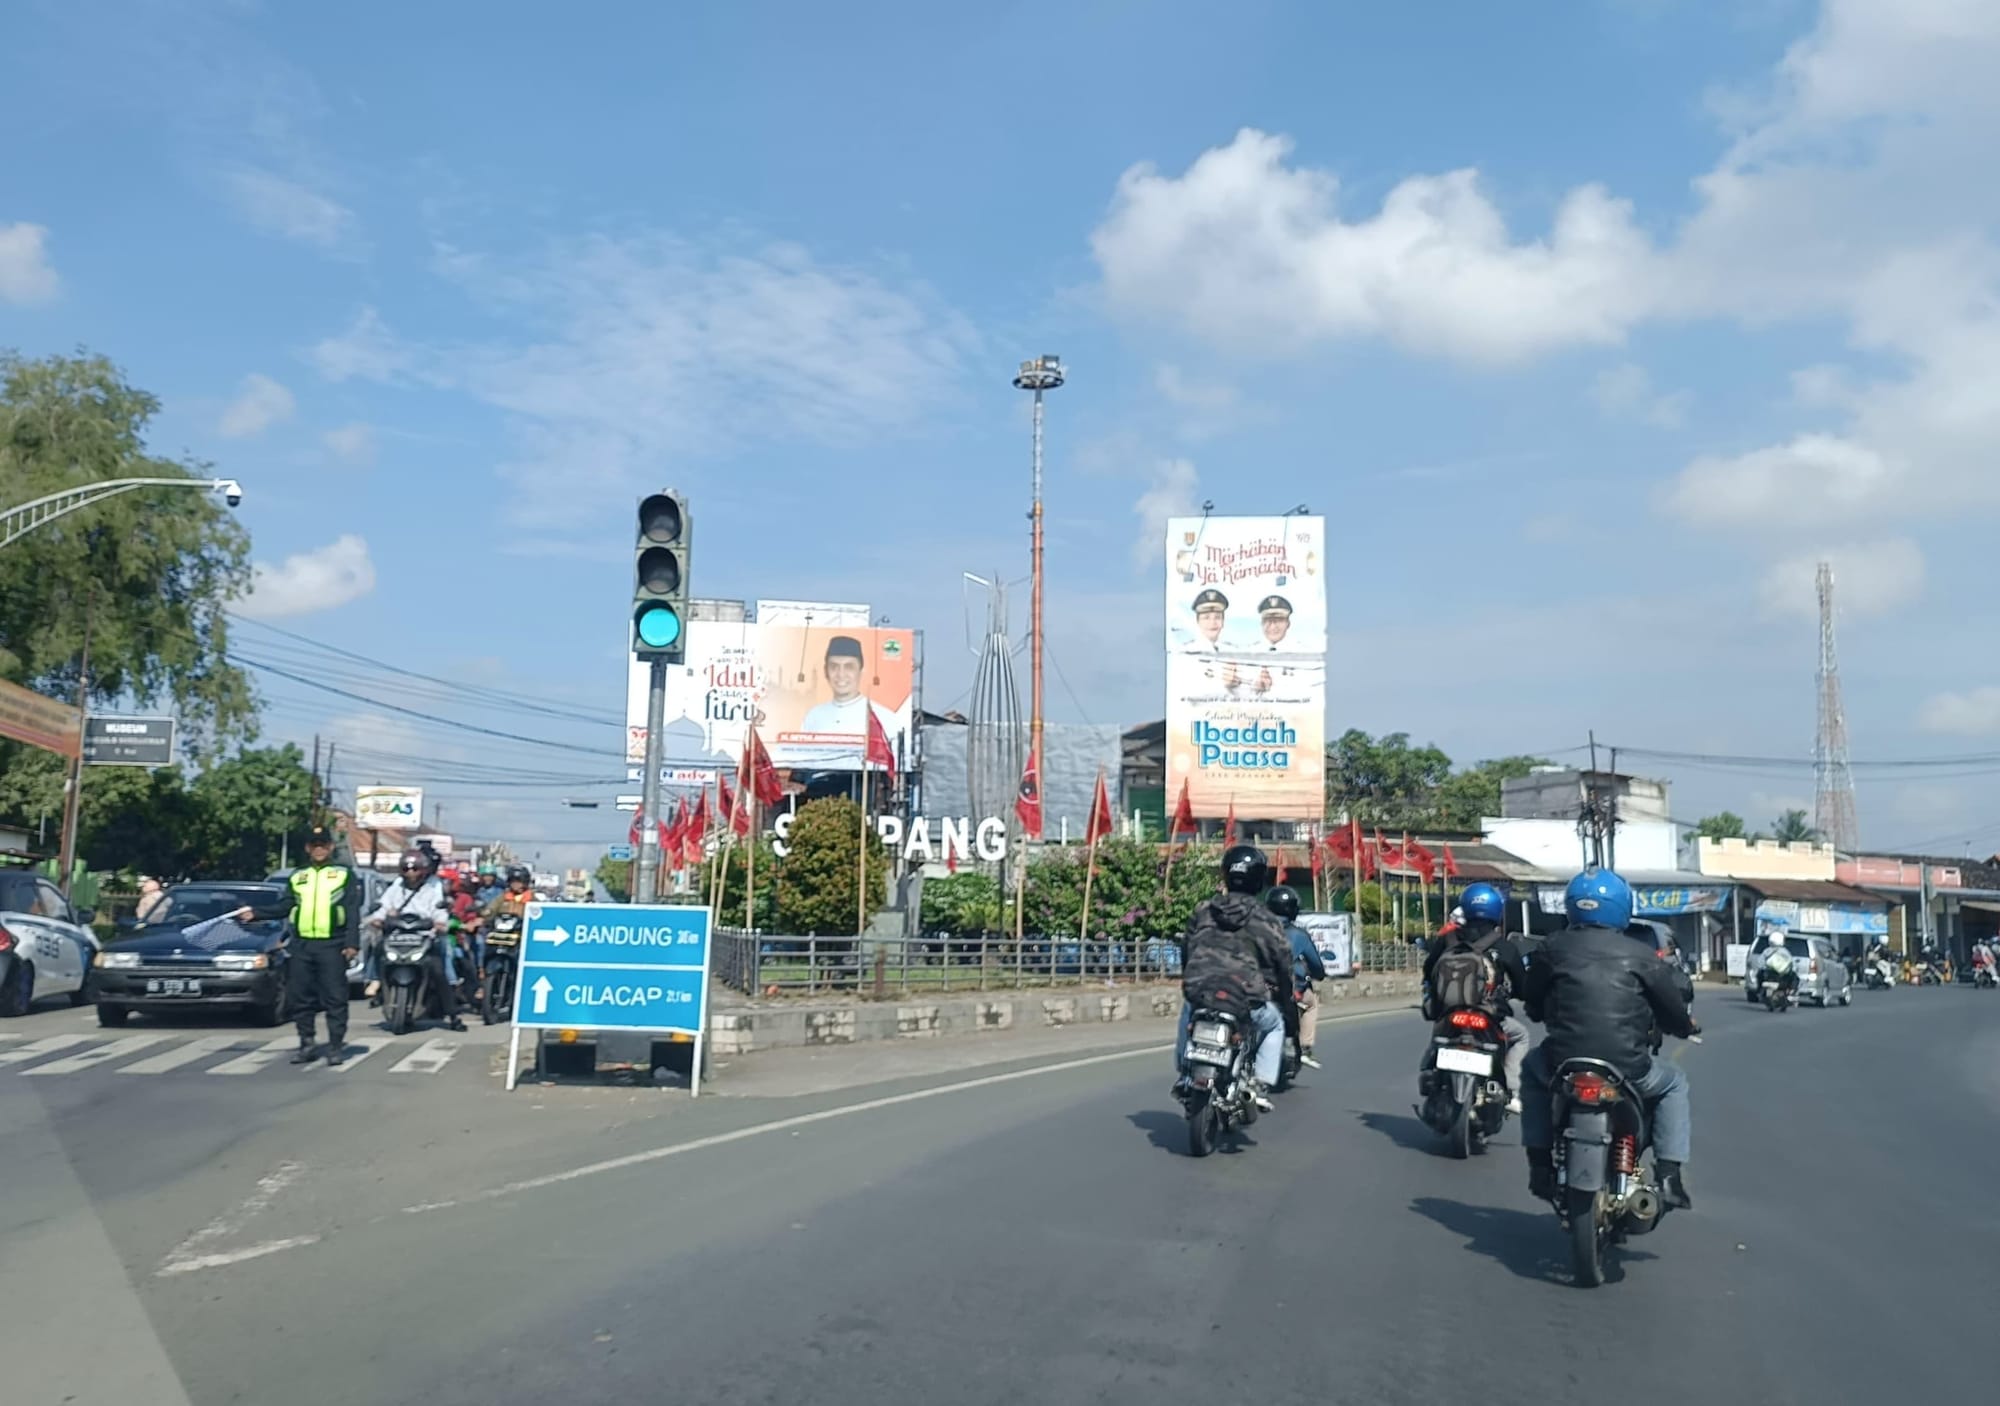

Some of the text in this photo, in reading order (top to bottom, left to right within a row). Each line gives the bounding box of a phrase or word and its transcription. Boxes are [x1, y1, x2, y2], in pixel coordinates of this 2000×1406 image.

[1192, 720, 1297, 745] Ibadah
[1200, 744, 1289, 767] Puasa
[772, 813, 1008, 861] SPANG
[574, 925, 673, 946] BANDUNG
[564, 985, 663, 1006] CILACAP
